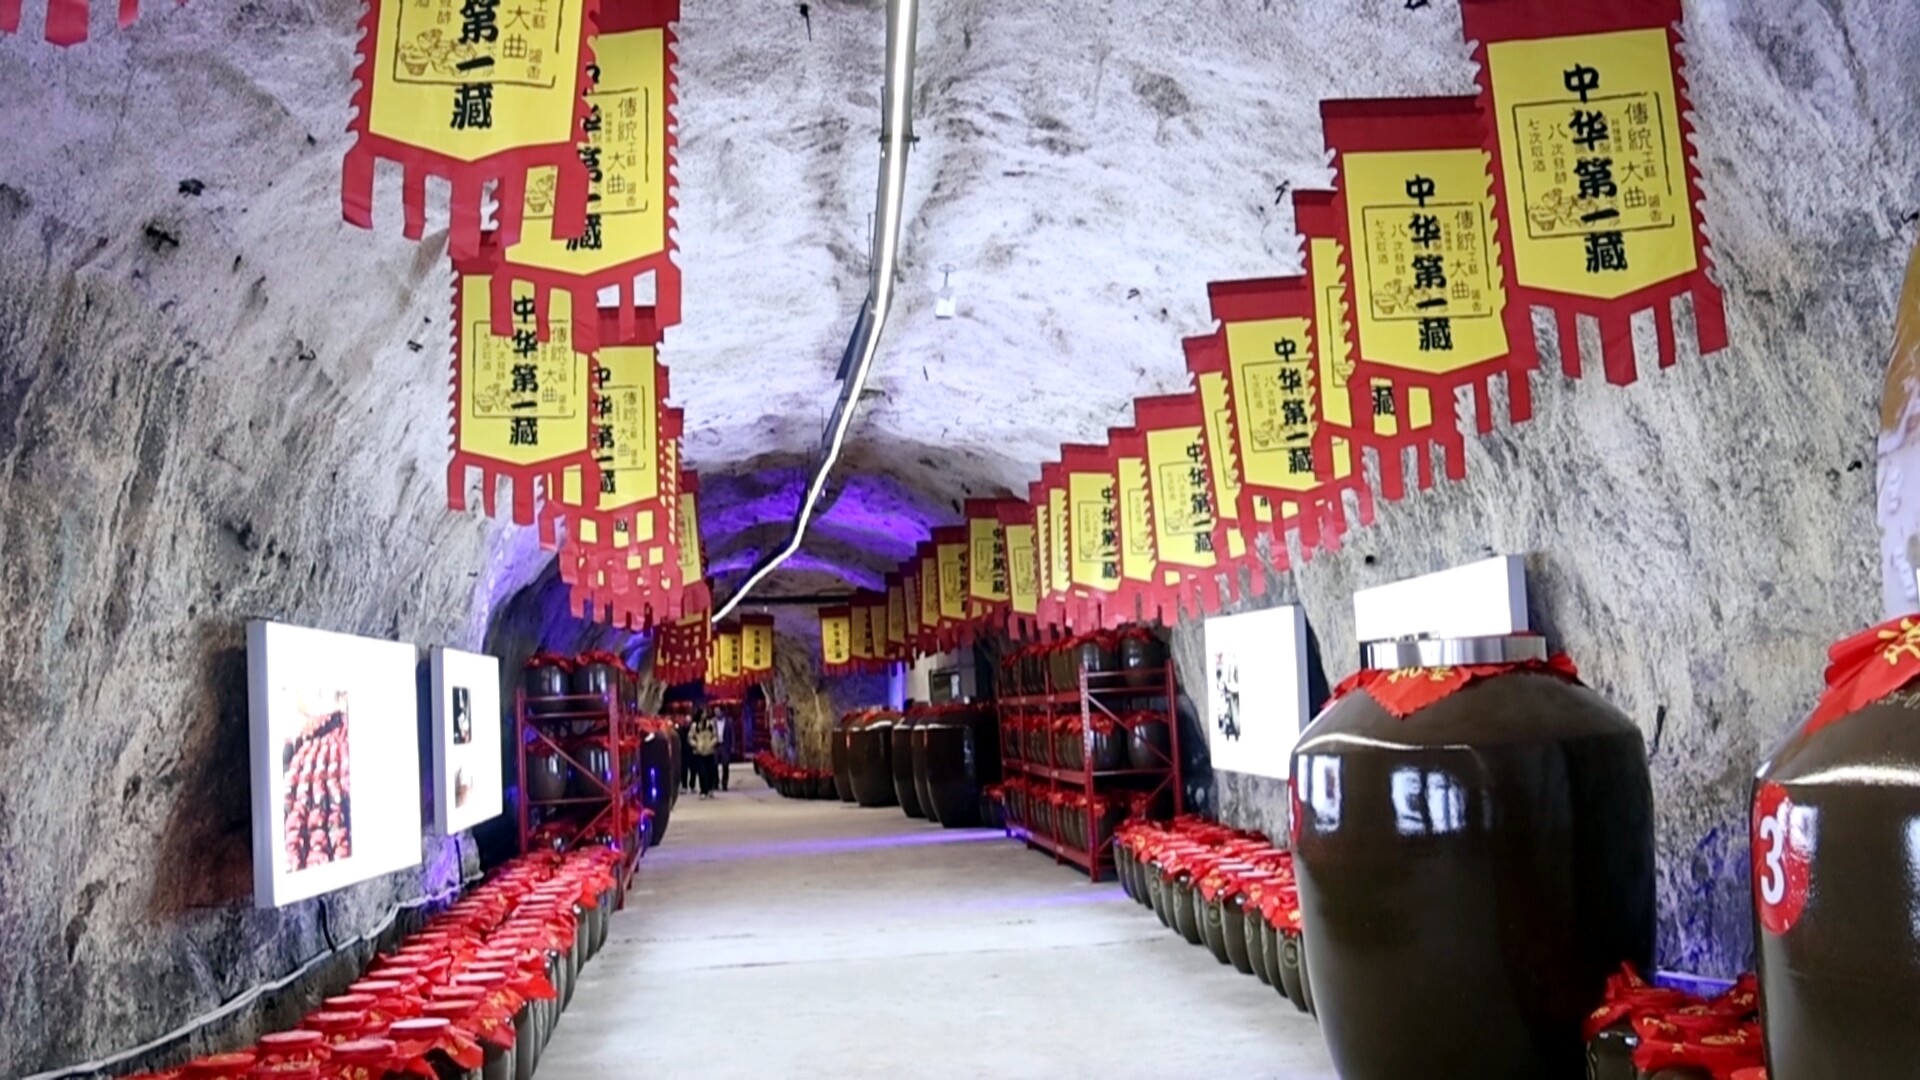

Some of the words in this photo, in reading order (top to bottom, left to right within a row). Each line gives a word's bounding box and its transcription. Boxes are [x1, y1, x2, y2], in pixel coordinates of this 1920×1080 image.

[450, 0, 500, 130] 第一藏
[1564, 64, 1628, 273] 中华第一藏
[1405, 173, 1453, 352] 中华第一藏
[509, 295, 539, 446] 中华第一藏
[1274, 337, 1313, 475] 中华第一藏
[1187, 442, 1214, 553] 中华第一藏
[1760, 816, 1785, 905] 3
